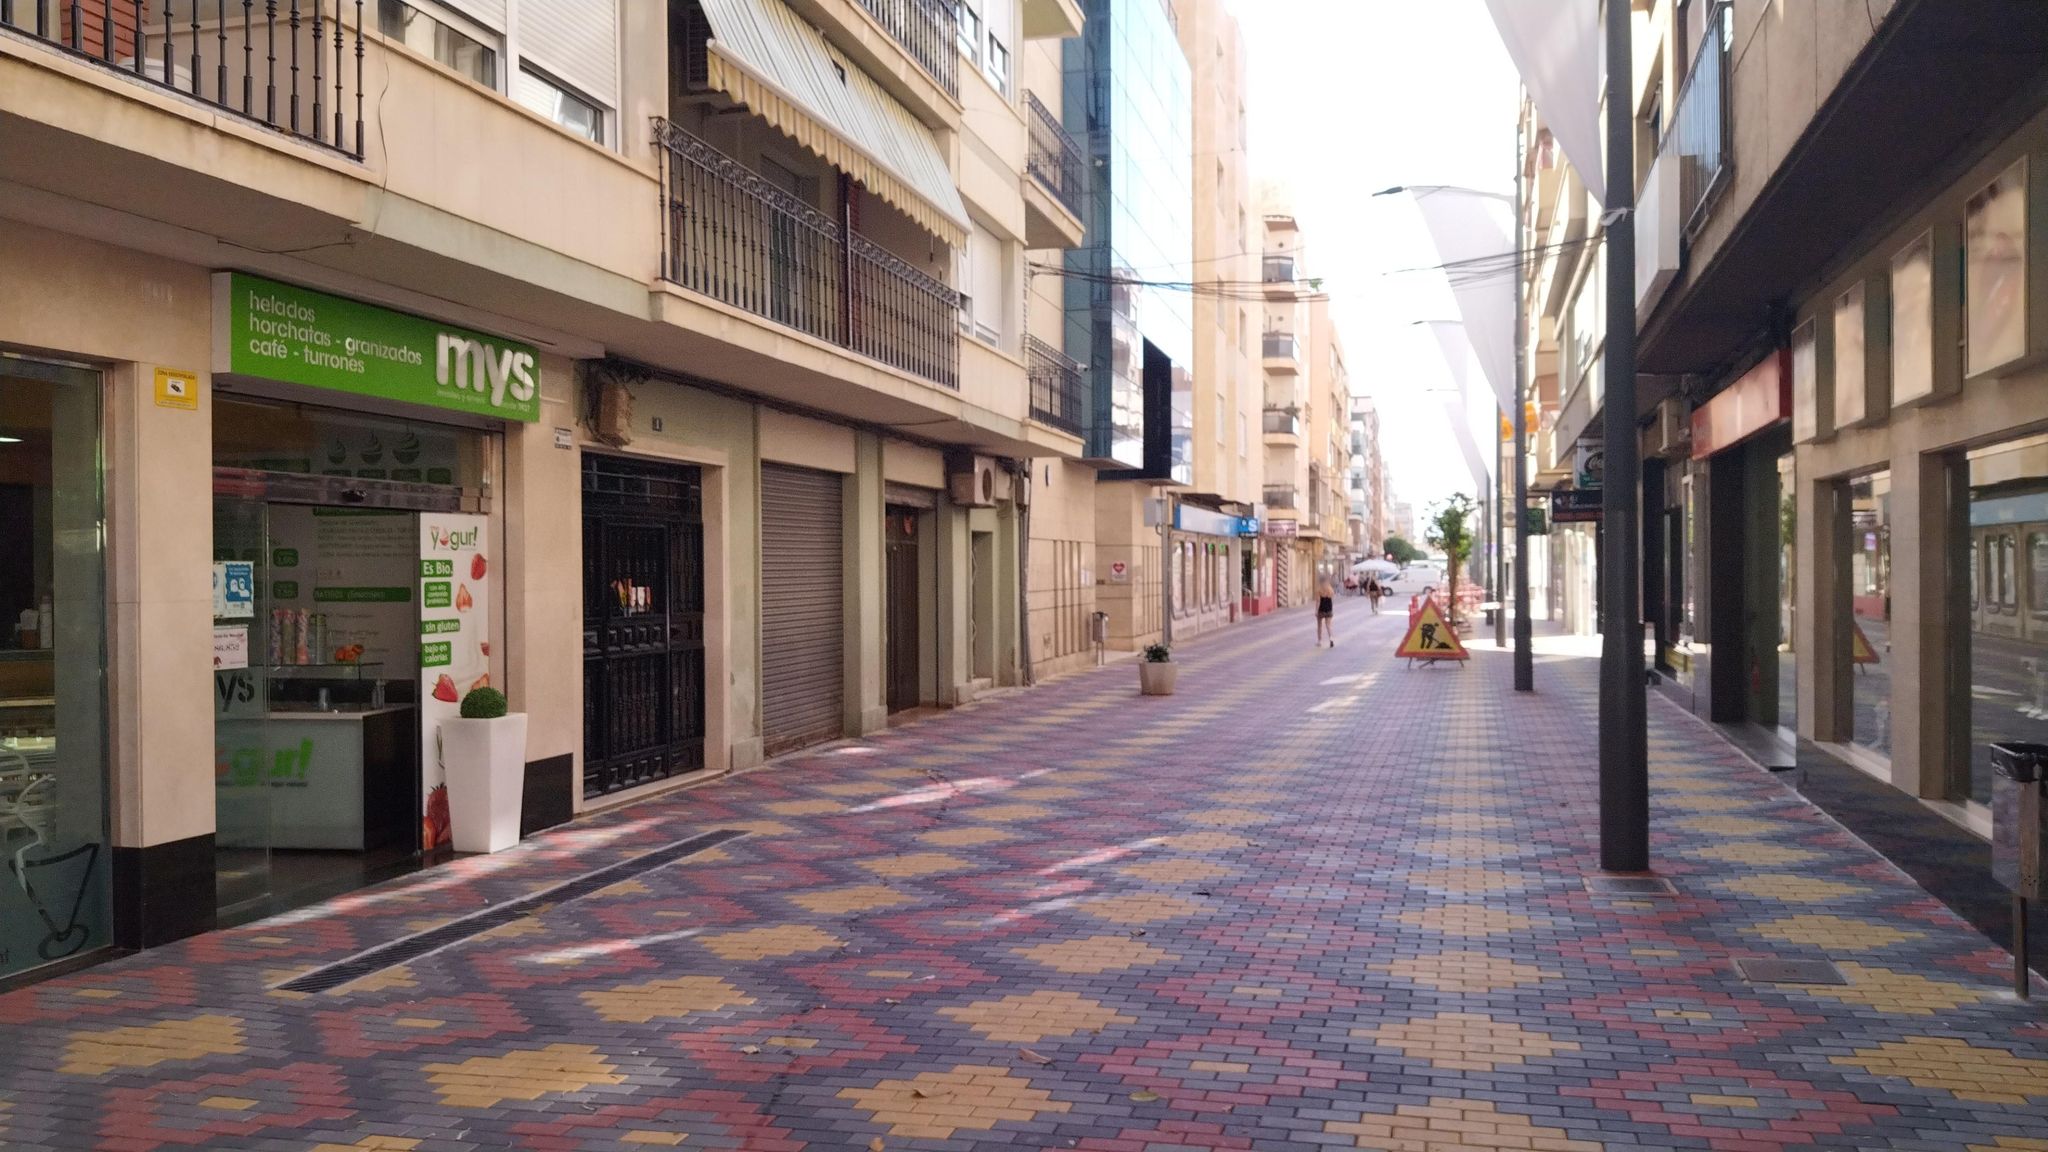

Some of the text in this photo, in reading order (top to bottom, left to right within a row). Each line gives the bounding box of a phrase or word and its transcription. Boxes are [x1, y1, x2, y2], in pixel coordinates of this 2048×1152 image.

[249, 290, 316, 322] helados
[249, 312, 331, 347] horchatas
[345, 337, 423, 365] granizados
[249, 339, 288, 359] café
[303, 344, 365, 374] turrones
[436, 332, 535, 407] mys
[1248, 519, 1257, 532] S
[423, 561, 434, 575] Es
[425, 621, 460, 633] sin gluten
